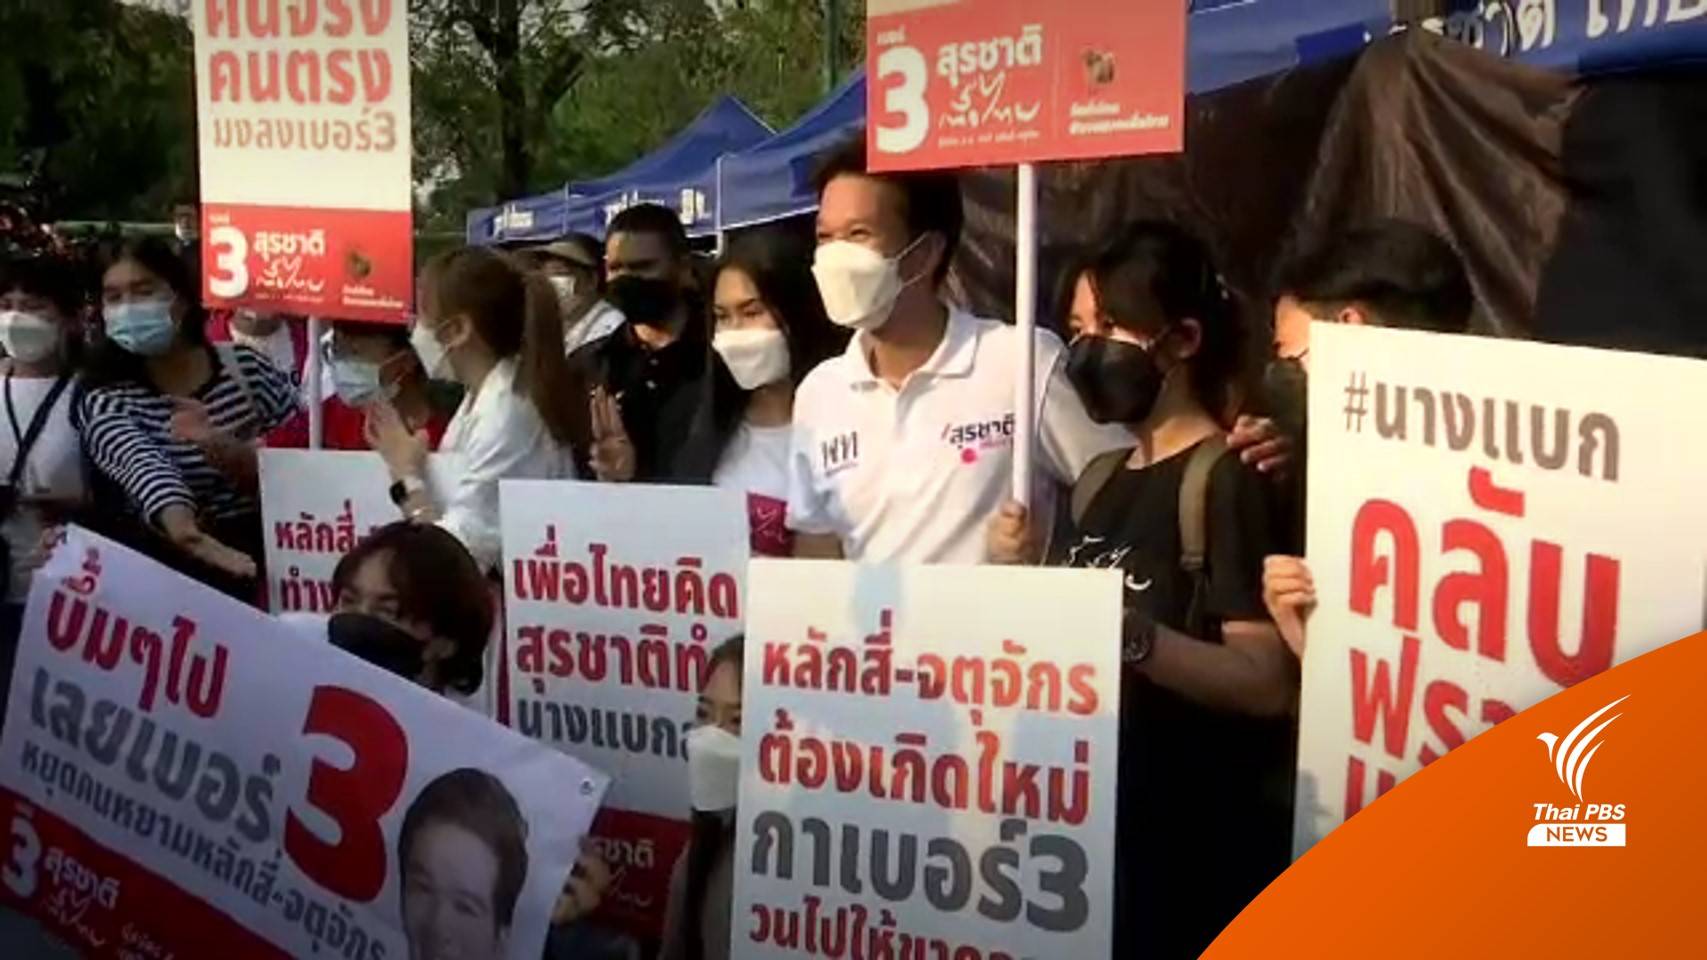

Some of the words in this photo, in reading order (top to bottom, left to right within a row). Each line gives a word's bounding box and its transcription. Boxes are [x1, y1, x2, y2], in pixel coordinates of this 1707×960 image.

[209, 48, 393, 105] คนตรง
[876, 46, 929, 154] 3
[937, 24, 1042, 87] สุรชาติ
[213, 107, 396, 151] มงลงเบอร์3
[208, 226, 249, 299] 3
[254, 229, 325, 261] สุรชาติ
[1344, 371, 1621, 482] #นางแบก
[513, 525, 738, 619] เพื่อไทยคิด
[1349, 466, 1622, 690] คลับ
[762, 609, 1100, 726] หลักสี่-จตุจักร
[30, 667, 282, 844] เลยเบอร์
[517, 698, 690, 759] นางแบก
[758, 708, 1090, 826] ต้องเกิดใหม่
[284, 685, 409, 904] 3
[2, 815, 41, 898] 3
[751, 809, 1090, 932] กาเบอร์3
